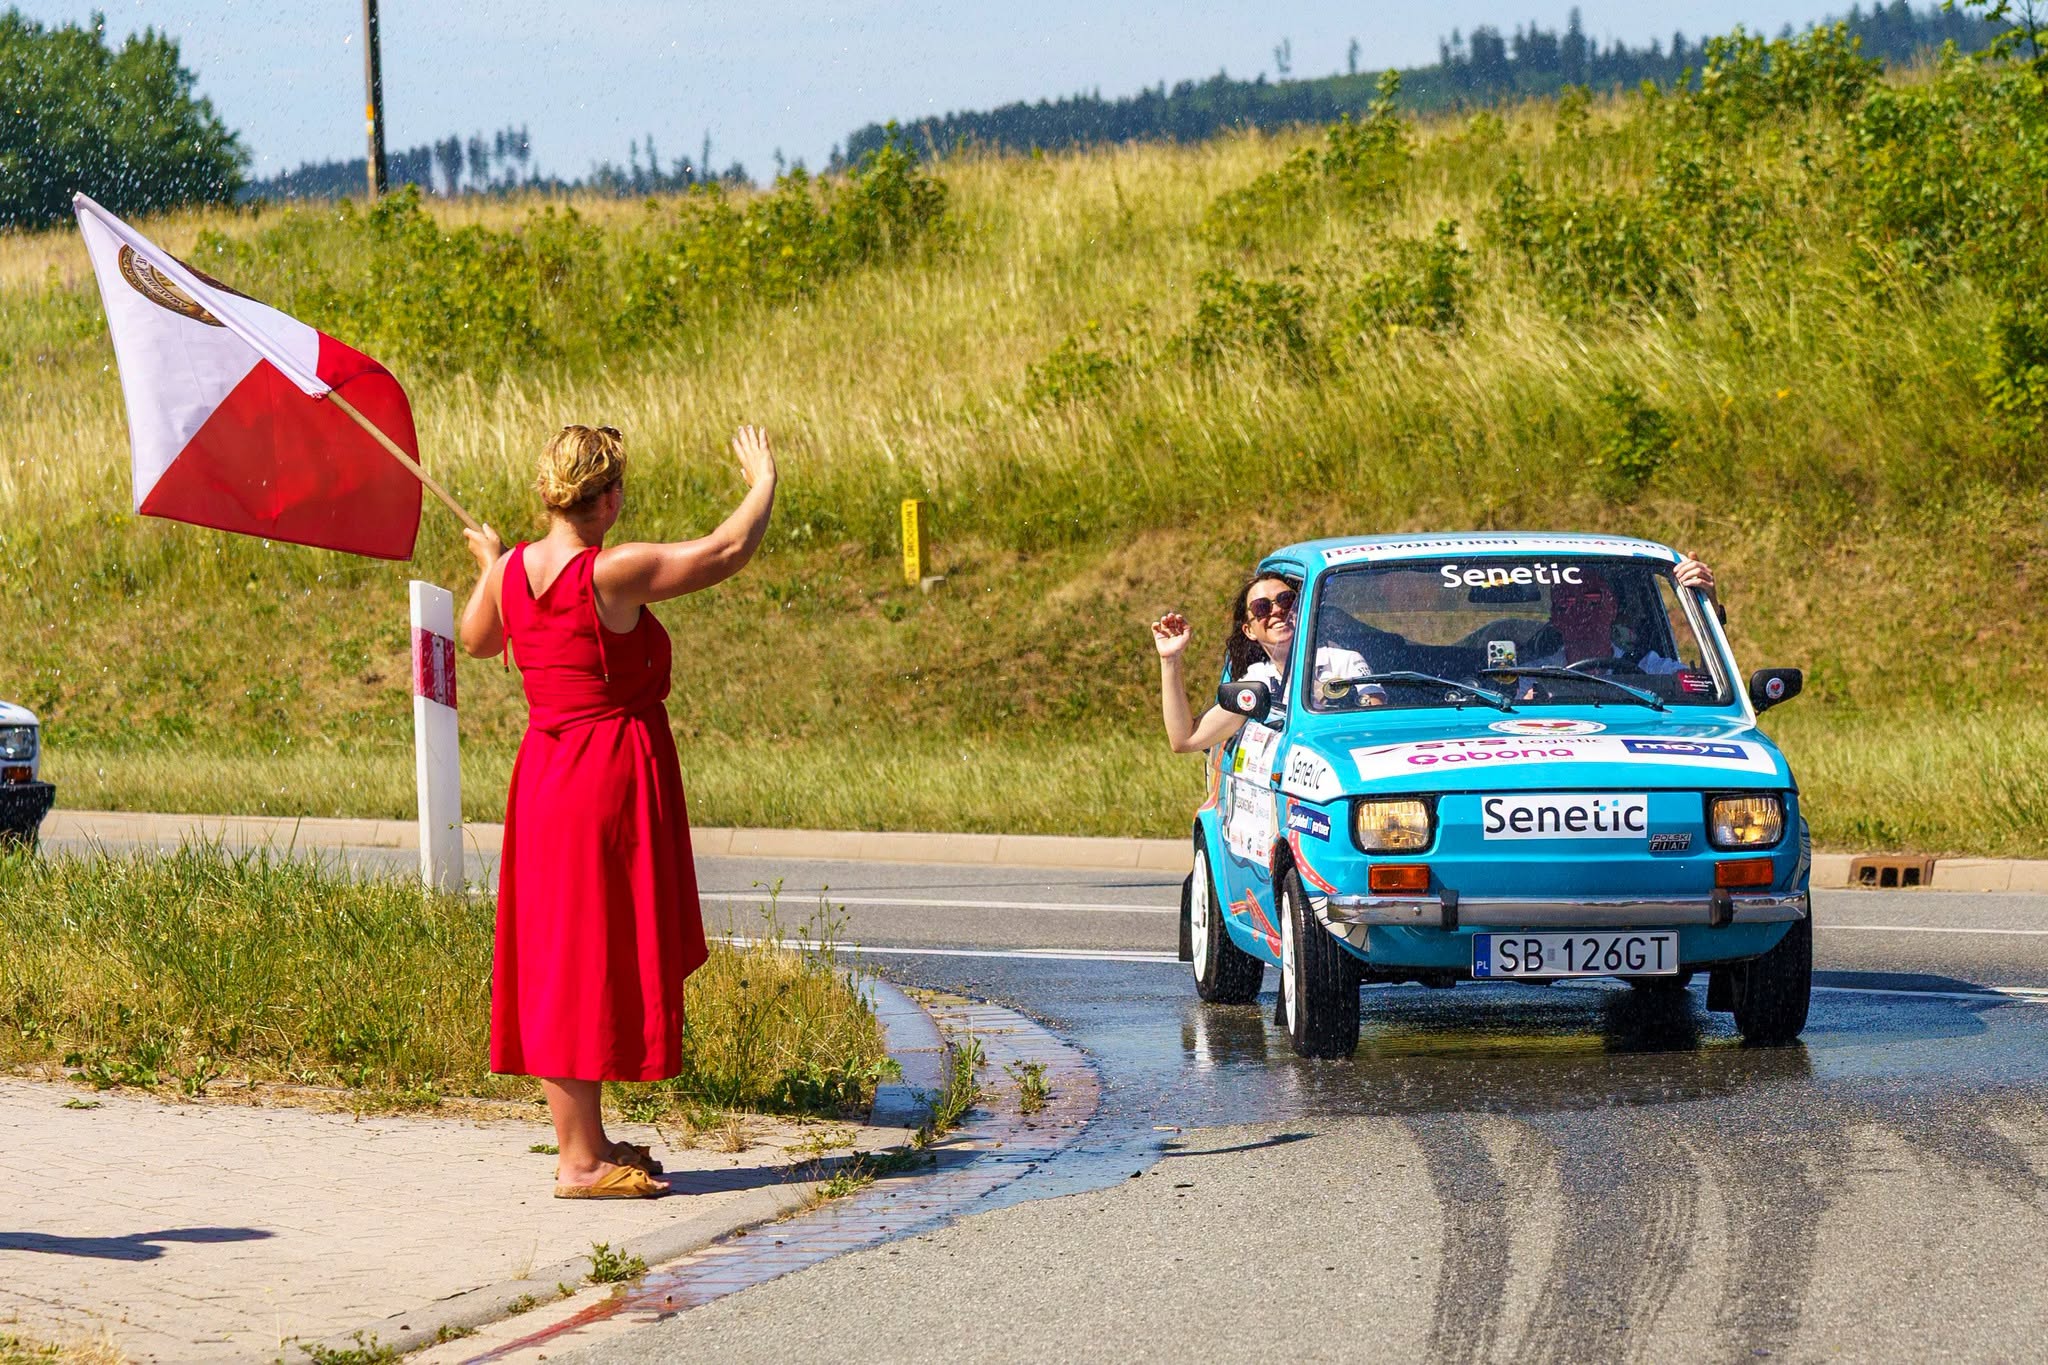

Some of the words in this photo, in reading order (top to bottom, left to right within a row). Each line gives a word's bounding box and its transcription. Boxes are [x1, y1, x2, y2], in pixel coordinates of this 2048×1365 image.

[1440, 562, 1583, 588] Senetic
[1415, 740, 1507, 750] STS
[1634, 743, 1737, 754] moya
[1407, 749, 1574, 765] Gabona
[1484, 798, 1645, 834] Senetic
[1652, 834, 1692, 842] POLSKI
[1651, 842, 1688, 850] FIAT
[1476, 961, 1489, 971] PL
[1499, 938, 1544, 973] SB
[1562, 936, 1670, 972] 126GT
